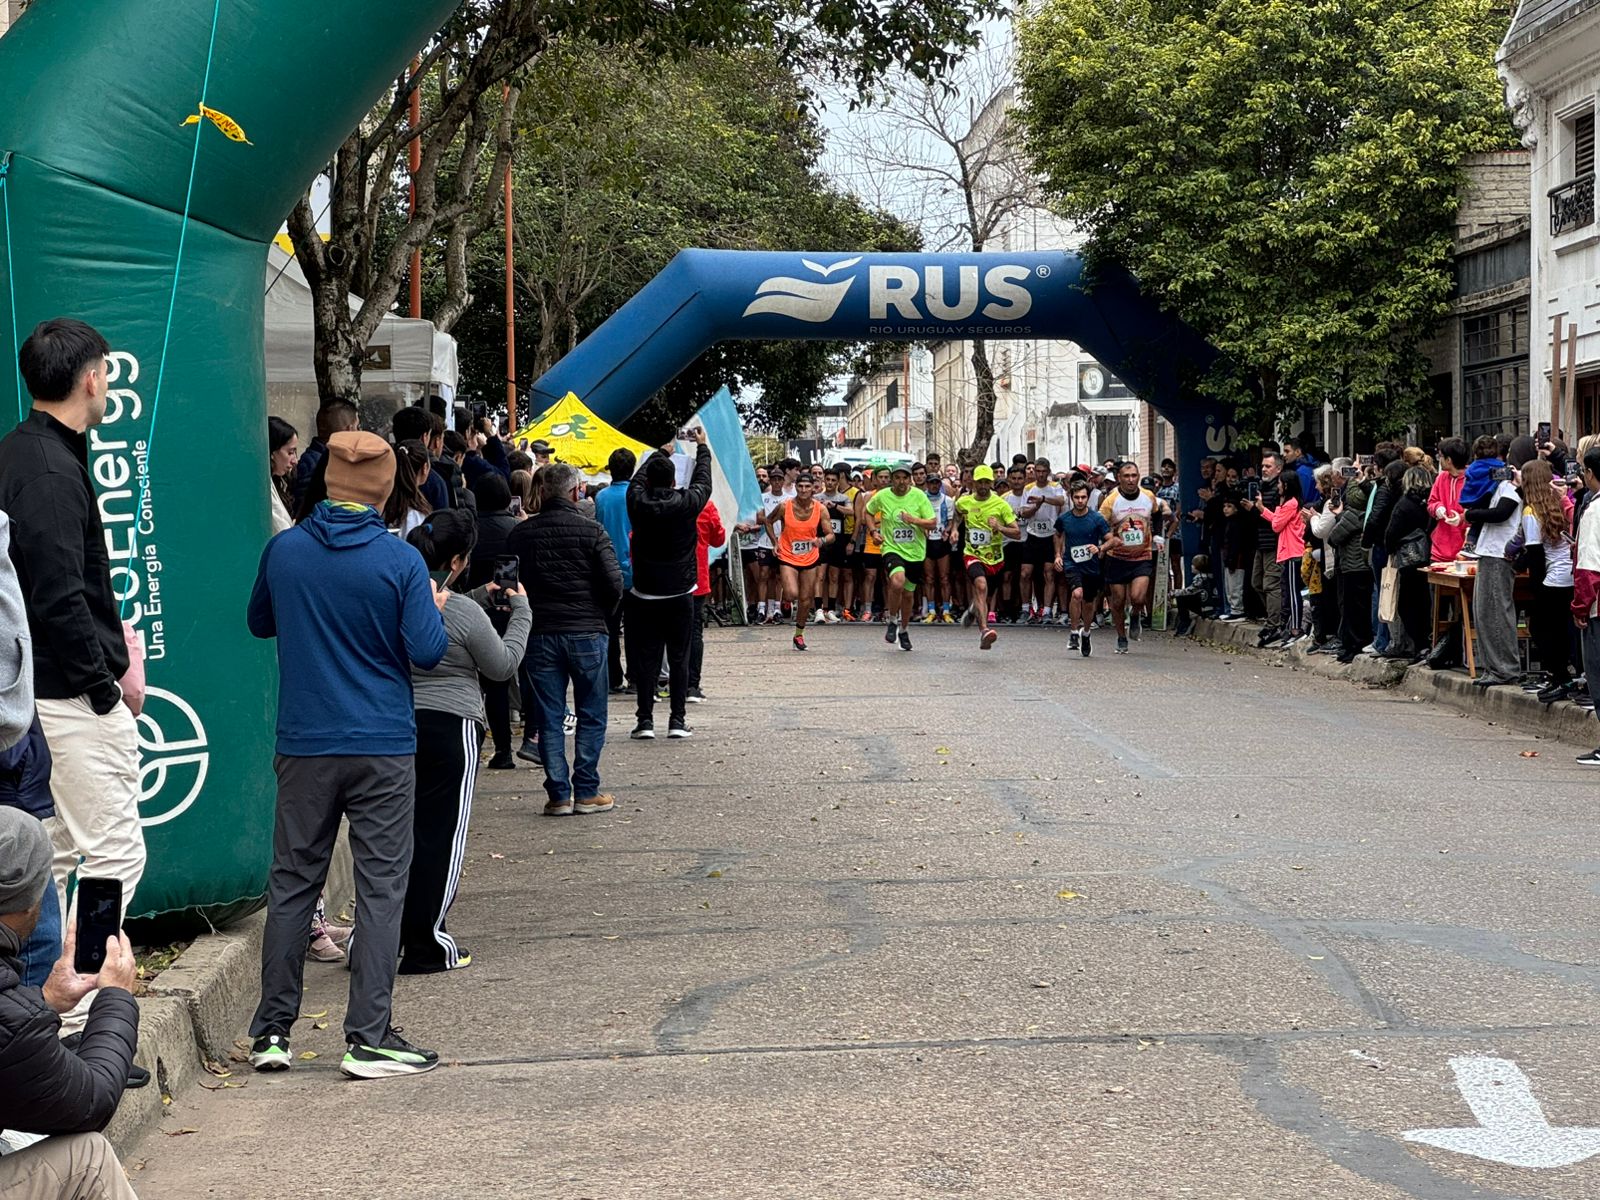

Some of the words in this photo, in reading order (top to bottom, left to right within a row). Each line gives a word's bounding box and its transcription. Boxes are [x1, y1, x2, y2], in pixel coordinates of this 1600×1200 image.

[869, 264, 1032, 321] RUS
[869, 326, 893, 335] RIO
[897, 326, 964, 335] URUGUAY
[967, 326, 1032, 335] SEGUROS
[131, 440, 155, 535] Consciente
[895, 529, 913, 539] 232
[972, 531, 985, 542] 39
[1124, 532, 1141, 542] 934
[794, 541, 810, 551] 231
[1073, 546, 1091, 559] 233
[142, 544, 163, 616] Energía
[148, 620, 166, 660] Una
